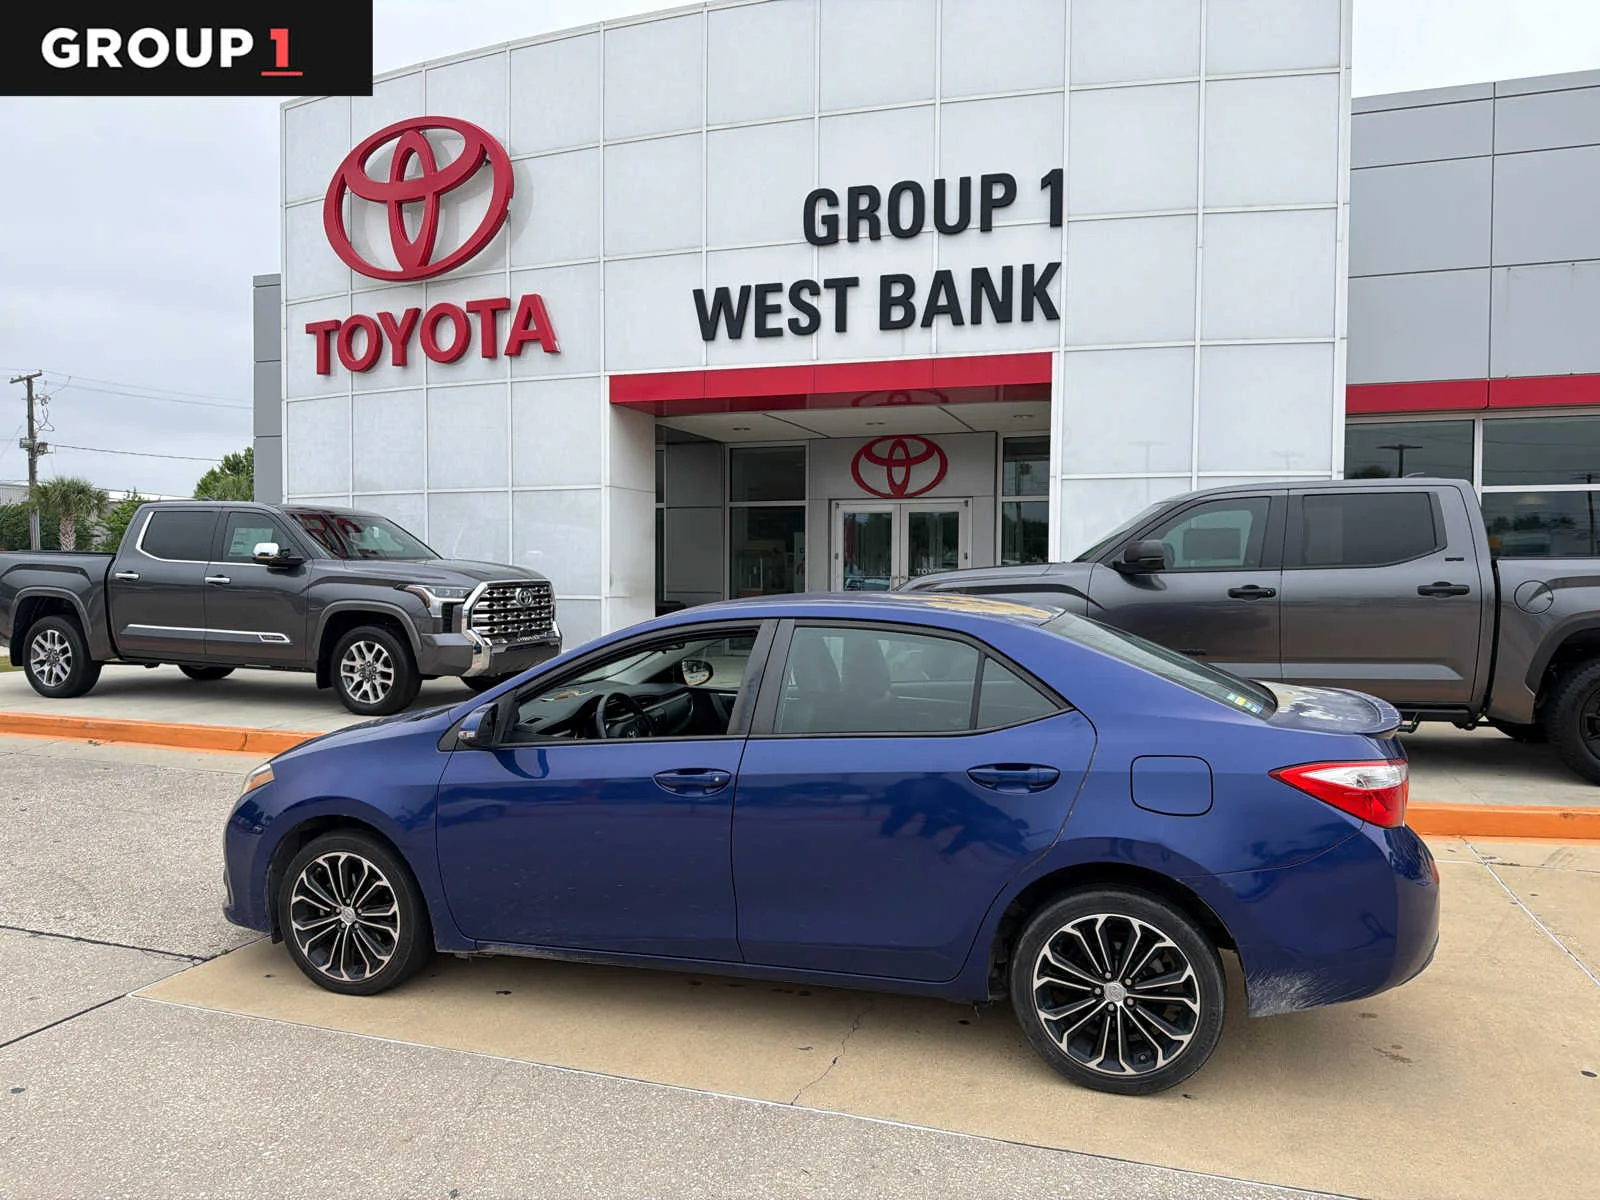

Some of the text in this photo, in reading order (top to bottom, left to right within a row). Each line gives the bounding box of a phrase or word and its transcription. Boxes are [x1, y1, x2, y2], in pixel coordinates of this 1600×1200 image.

[803, 168, 1064, 246] GROUP 1
[305, 293, 561, 375] TOYOTA
[692, 261, 1062, 342] WEST BANK
